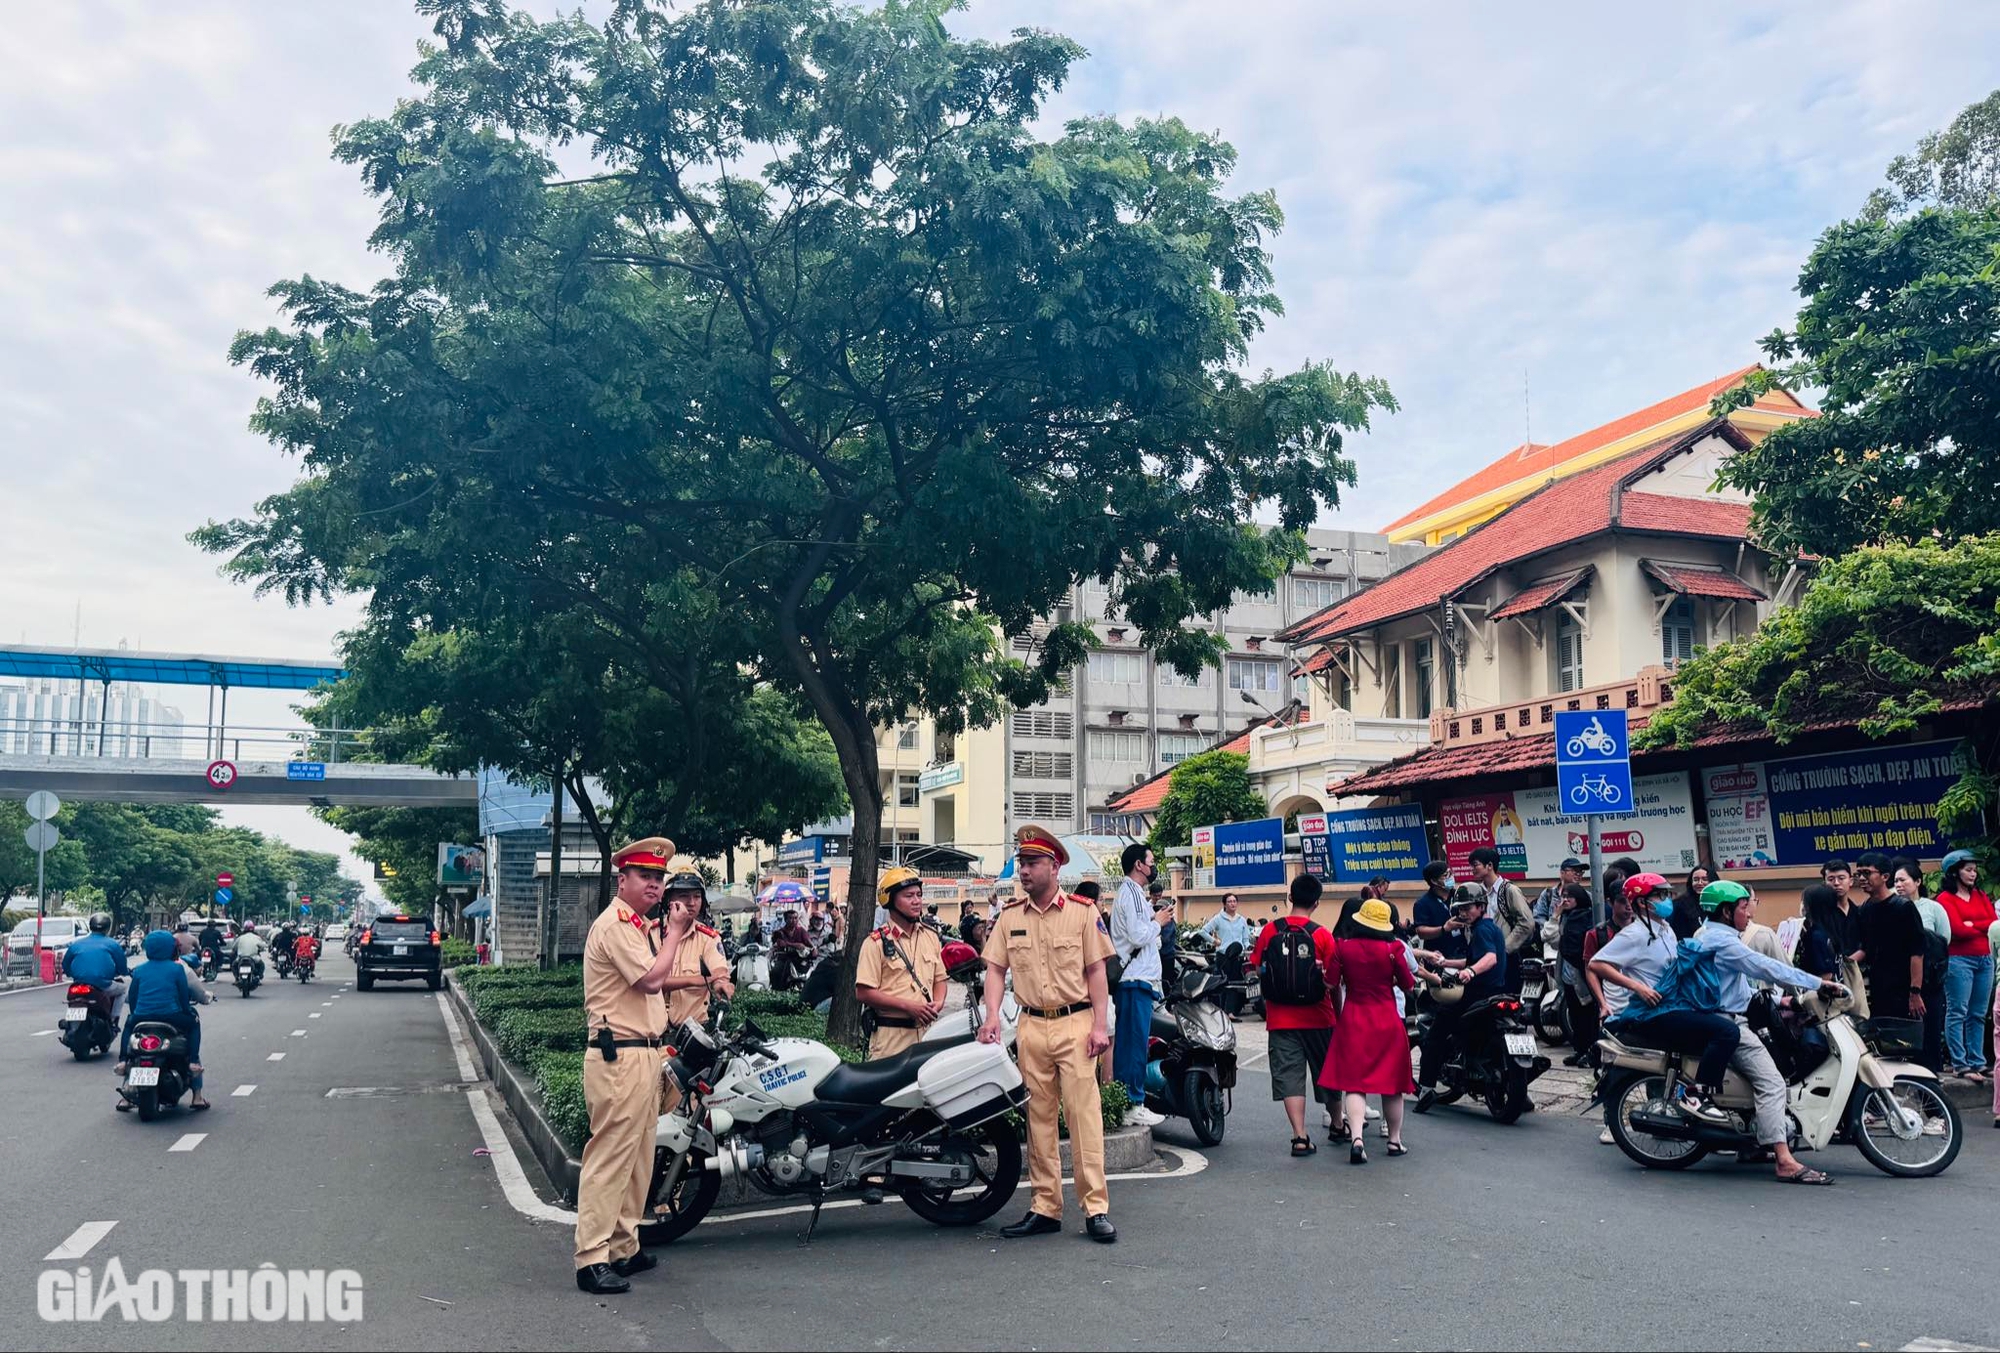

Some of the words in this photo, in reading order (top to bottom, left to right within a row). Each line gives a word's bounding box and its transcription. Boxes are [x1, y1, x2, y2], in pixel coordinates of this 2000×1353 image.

[1771, 768, 1801, 793] CỔNG
[1801, 766, 1849, 790] TRƯỜNG
[1913, 758, 1931, 779] AN
[1710, 808, 1722, 818] DU
[1723, 806, 1743, 819] HỌC
[1745, 800, 1766, 819] EF
[1857, 804, 1874, 823] khi
[1899, 802, 1923, 821] trên
[1444, 814, 1464, 827] DOL
[1465, 812, 1489, 826] IELTS
[1446, 828, 1469, 844] ĐÌNH
[1471, 828, 1490, 845] LỰC
[1615, 838, 1626, 846] 111
[1814, 834, 1827, 851] xe
[1872, 831, 1884, 847] xe
[1885, 829, 1906, 851] đạp
[1907, 827, 1936, 849] điện.
[1508, 846, 1525, 855] IELTS
[760, 1064, 789, 1084] C.S.G.T
[764, 1077, 787, 1092] TRAFFIC
[788, 1069, 807, 1084] POLICE
